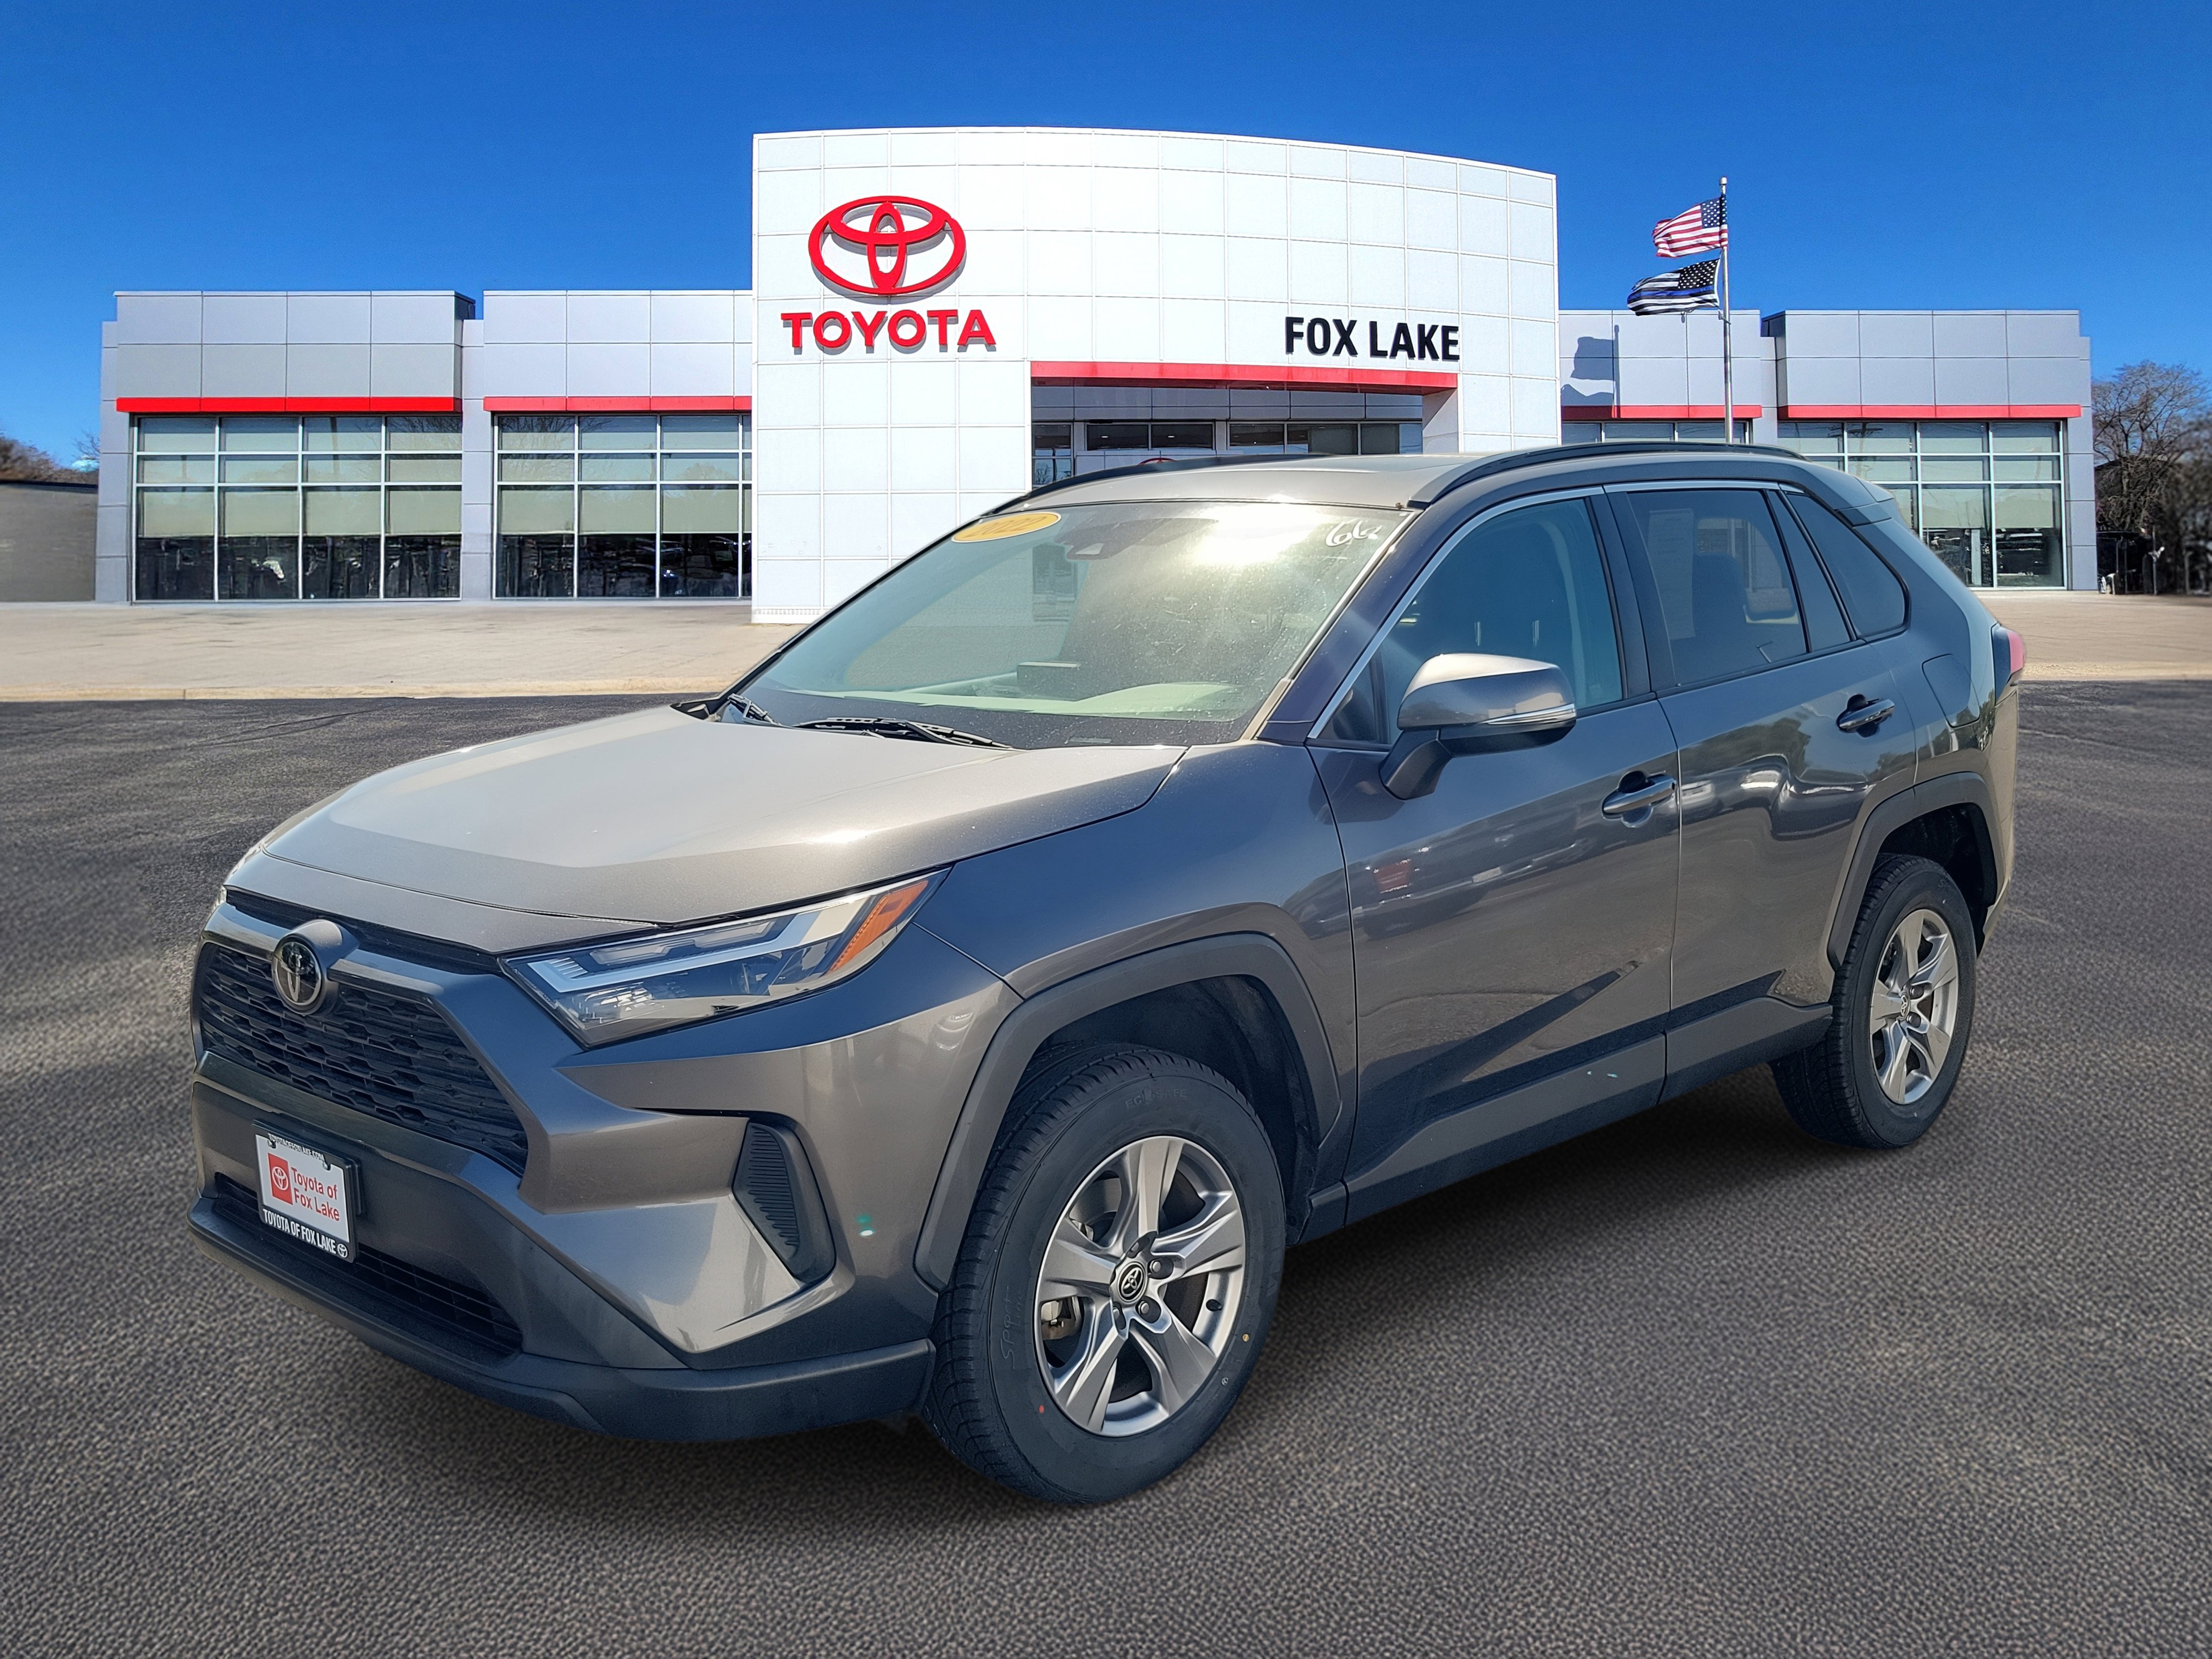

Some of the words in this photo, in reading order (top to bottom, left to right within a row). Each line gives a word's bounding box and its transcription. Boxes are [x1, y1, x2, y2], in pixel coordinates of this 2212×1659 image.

[781, 309, 997, 352] TOYOTA
[1286, 316, 1358, 357] FOX
[1369, 321, 1459, 361] LAKE
[291, 1167, 324, 1195] Toyota
[327, 1184, 337, 1200] of
[294, 1188, 313, 1210] Fox
[314, 1197, 340, 1221] Lake
[263, 1208, 290, 1233] TOYOTA
[291, 1221, 300, 1237] OF
[301, 1226, 316, 1245] FOX
[317, 1233, 336, 1254] LAKE
